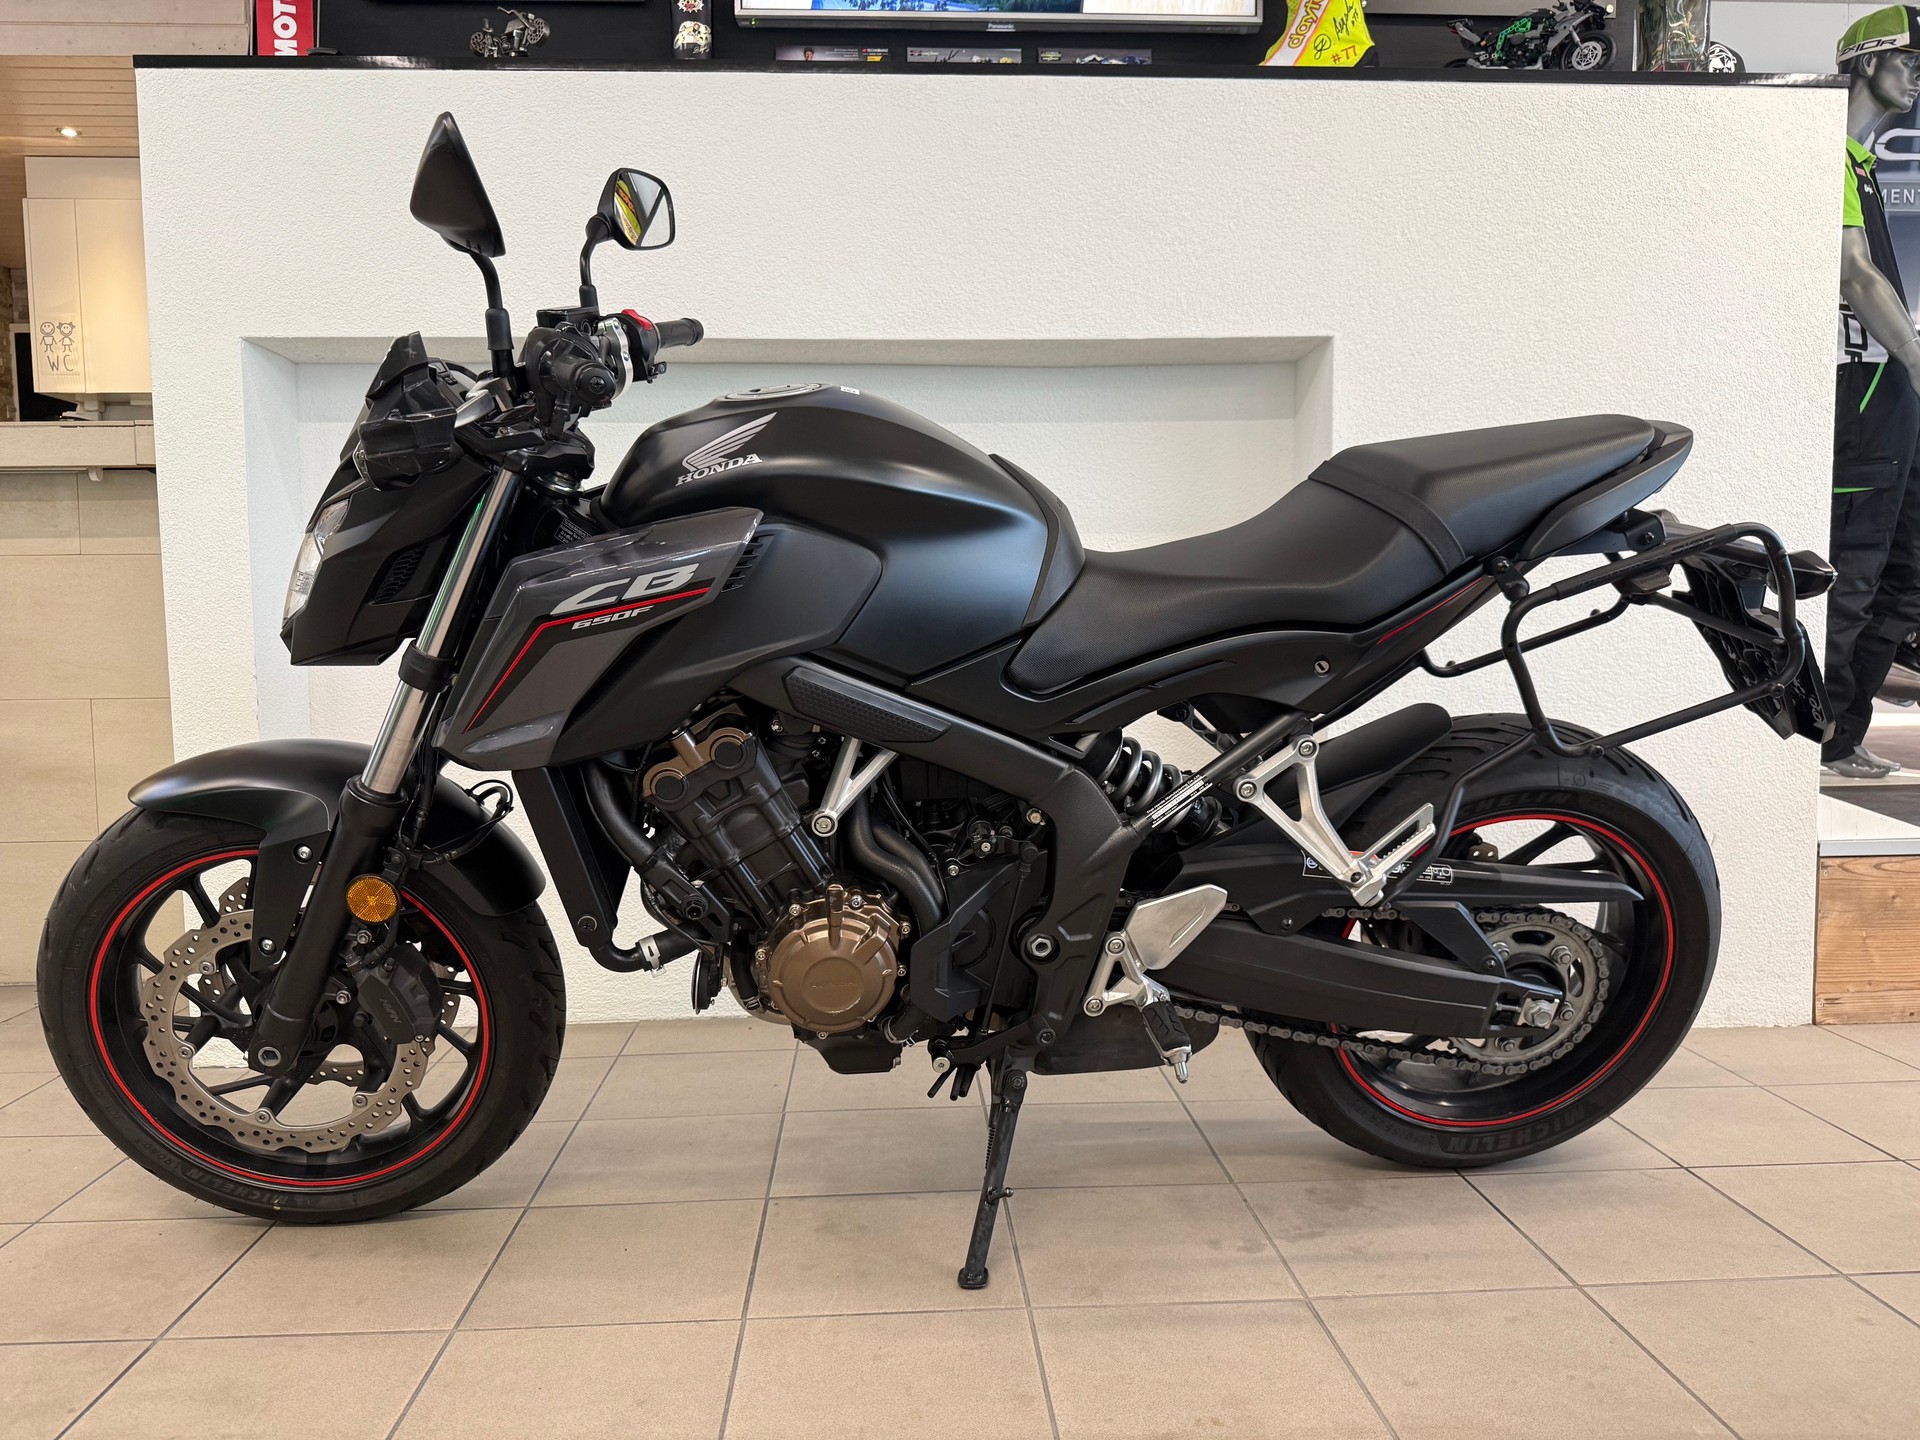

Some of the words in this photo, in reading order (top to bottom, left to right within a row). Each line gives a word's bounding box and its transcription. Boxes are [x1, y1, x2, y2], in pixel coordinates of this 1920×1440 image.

[675, 453, 763, 487] HONDA
[550, 563, 700, 616] CB
[571, 605, 655, 630] 650F
[1446, 1104, 1585, 1153] MICHELIN
[185, 1167, 289, 1205] MICHELIN
